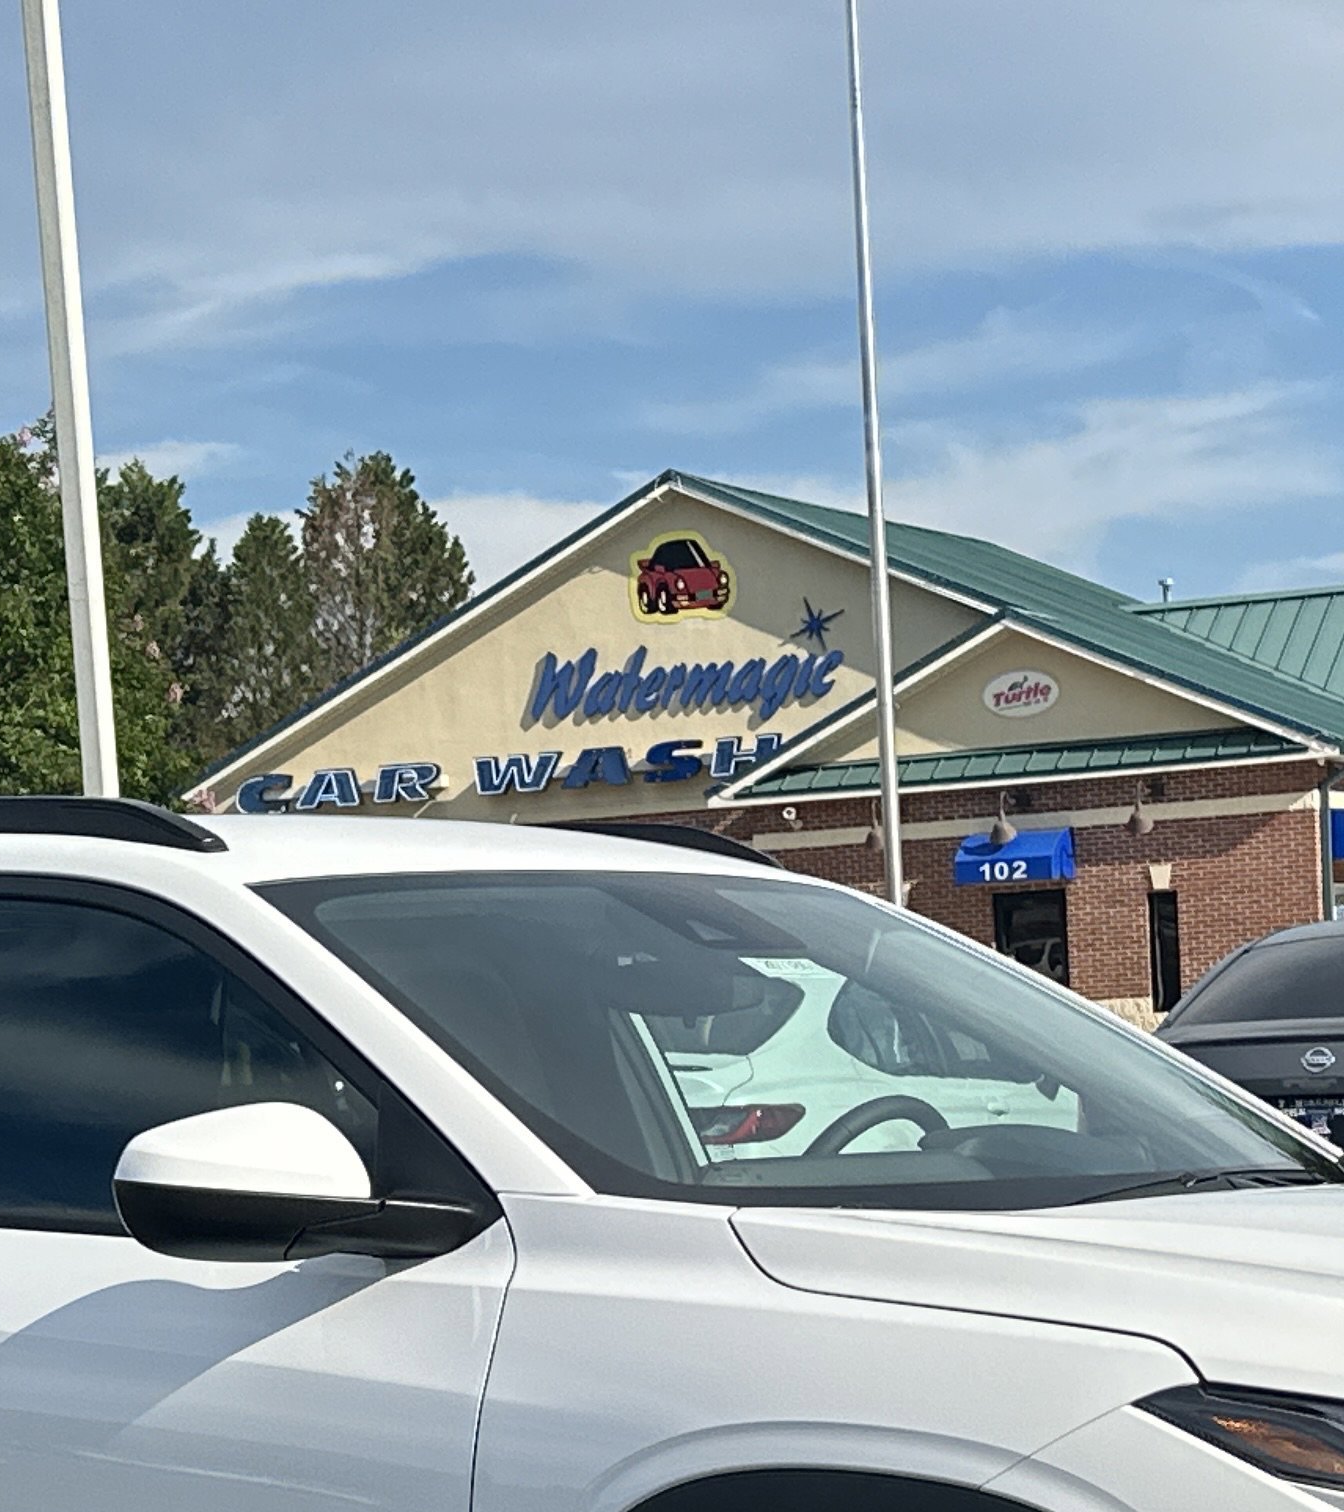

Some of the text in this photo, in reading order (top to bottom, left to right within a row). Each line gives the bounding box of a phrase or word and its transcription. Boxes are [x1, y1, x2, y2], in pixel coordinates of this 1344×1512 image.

[532, 646, 846, 722] Watermagic
[236, 733, 783, 815] CAR WASH
[979, 860, 1028, 882] 102
